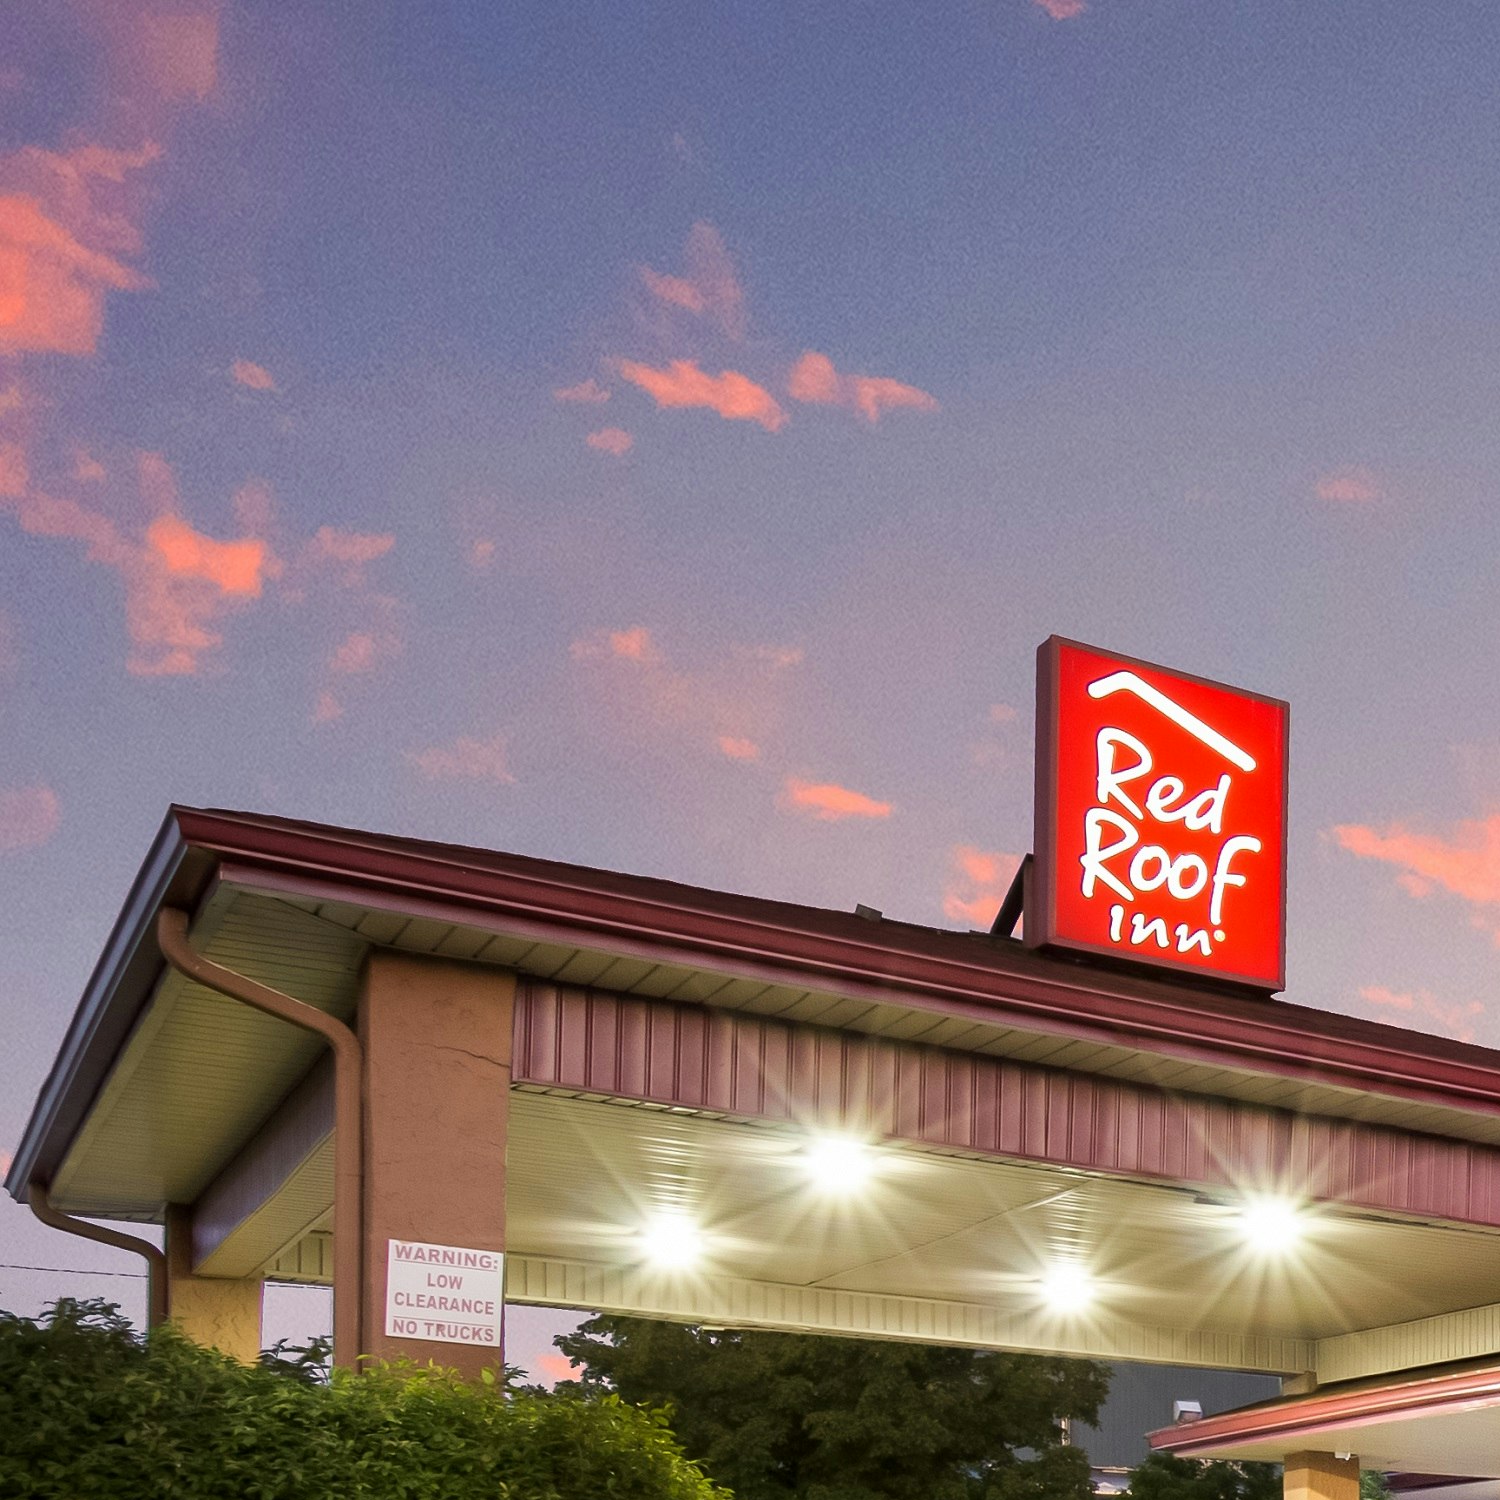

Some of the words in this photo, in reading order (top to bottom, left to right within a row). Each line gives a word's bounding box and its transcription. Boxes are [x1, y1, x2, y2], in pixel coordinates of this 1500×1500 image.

[1096, 726, 1232, 834] Red
[1080, 807, 1262, 926] Roof
[395, 1244, 498, 1270] WARNING:
[427, 1272, 463, 1290] LOW
[394, 1292, 495, 1315] CLEARANCE
[393, 1318, 418, 1335] NO
[424, 1322, 495, 1342] TRUCKS
